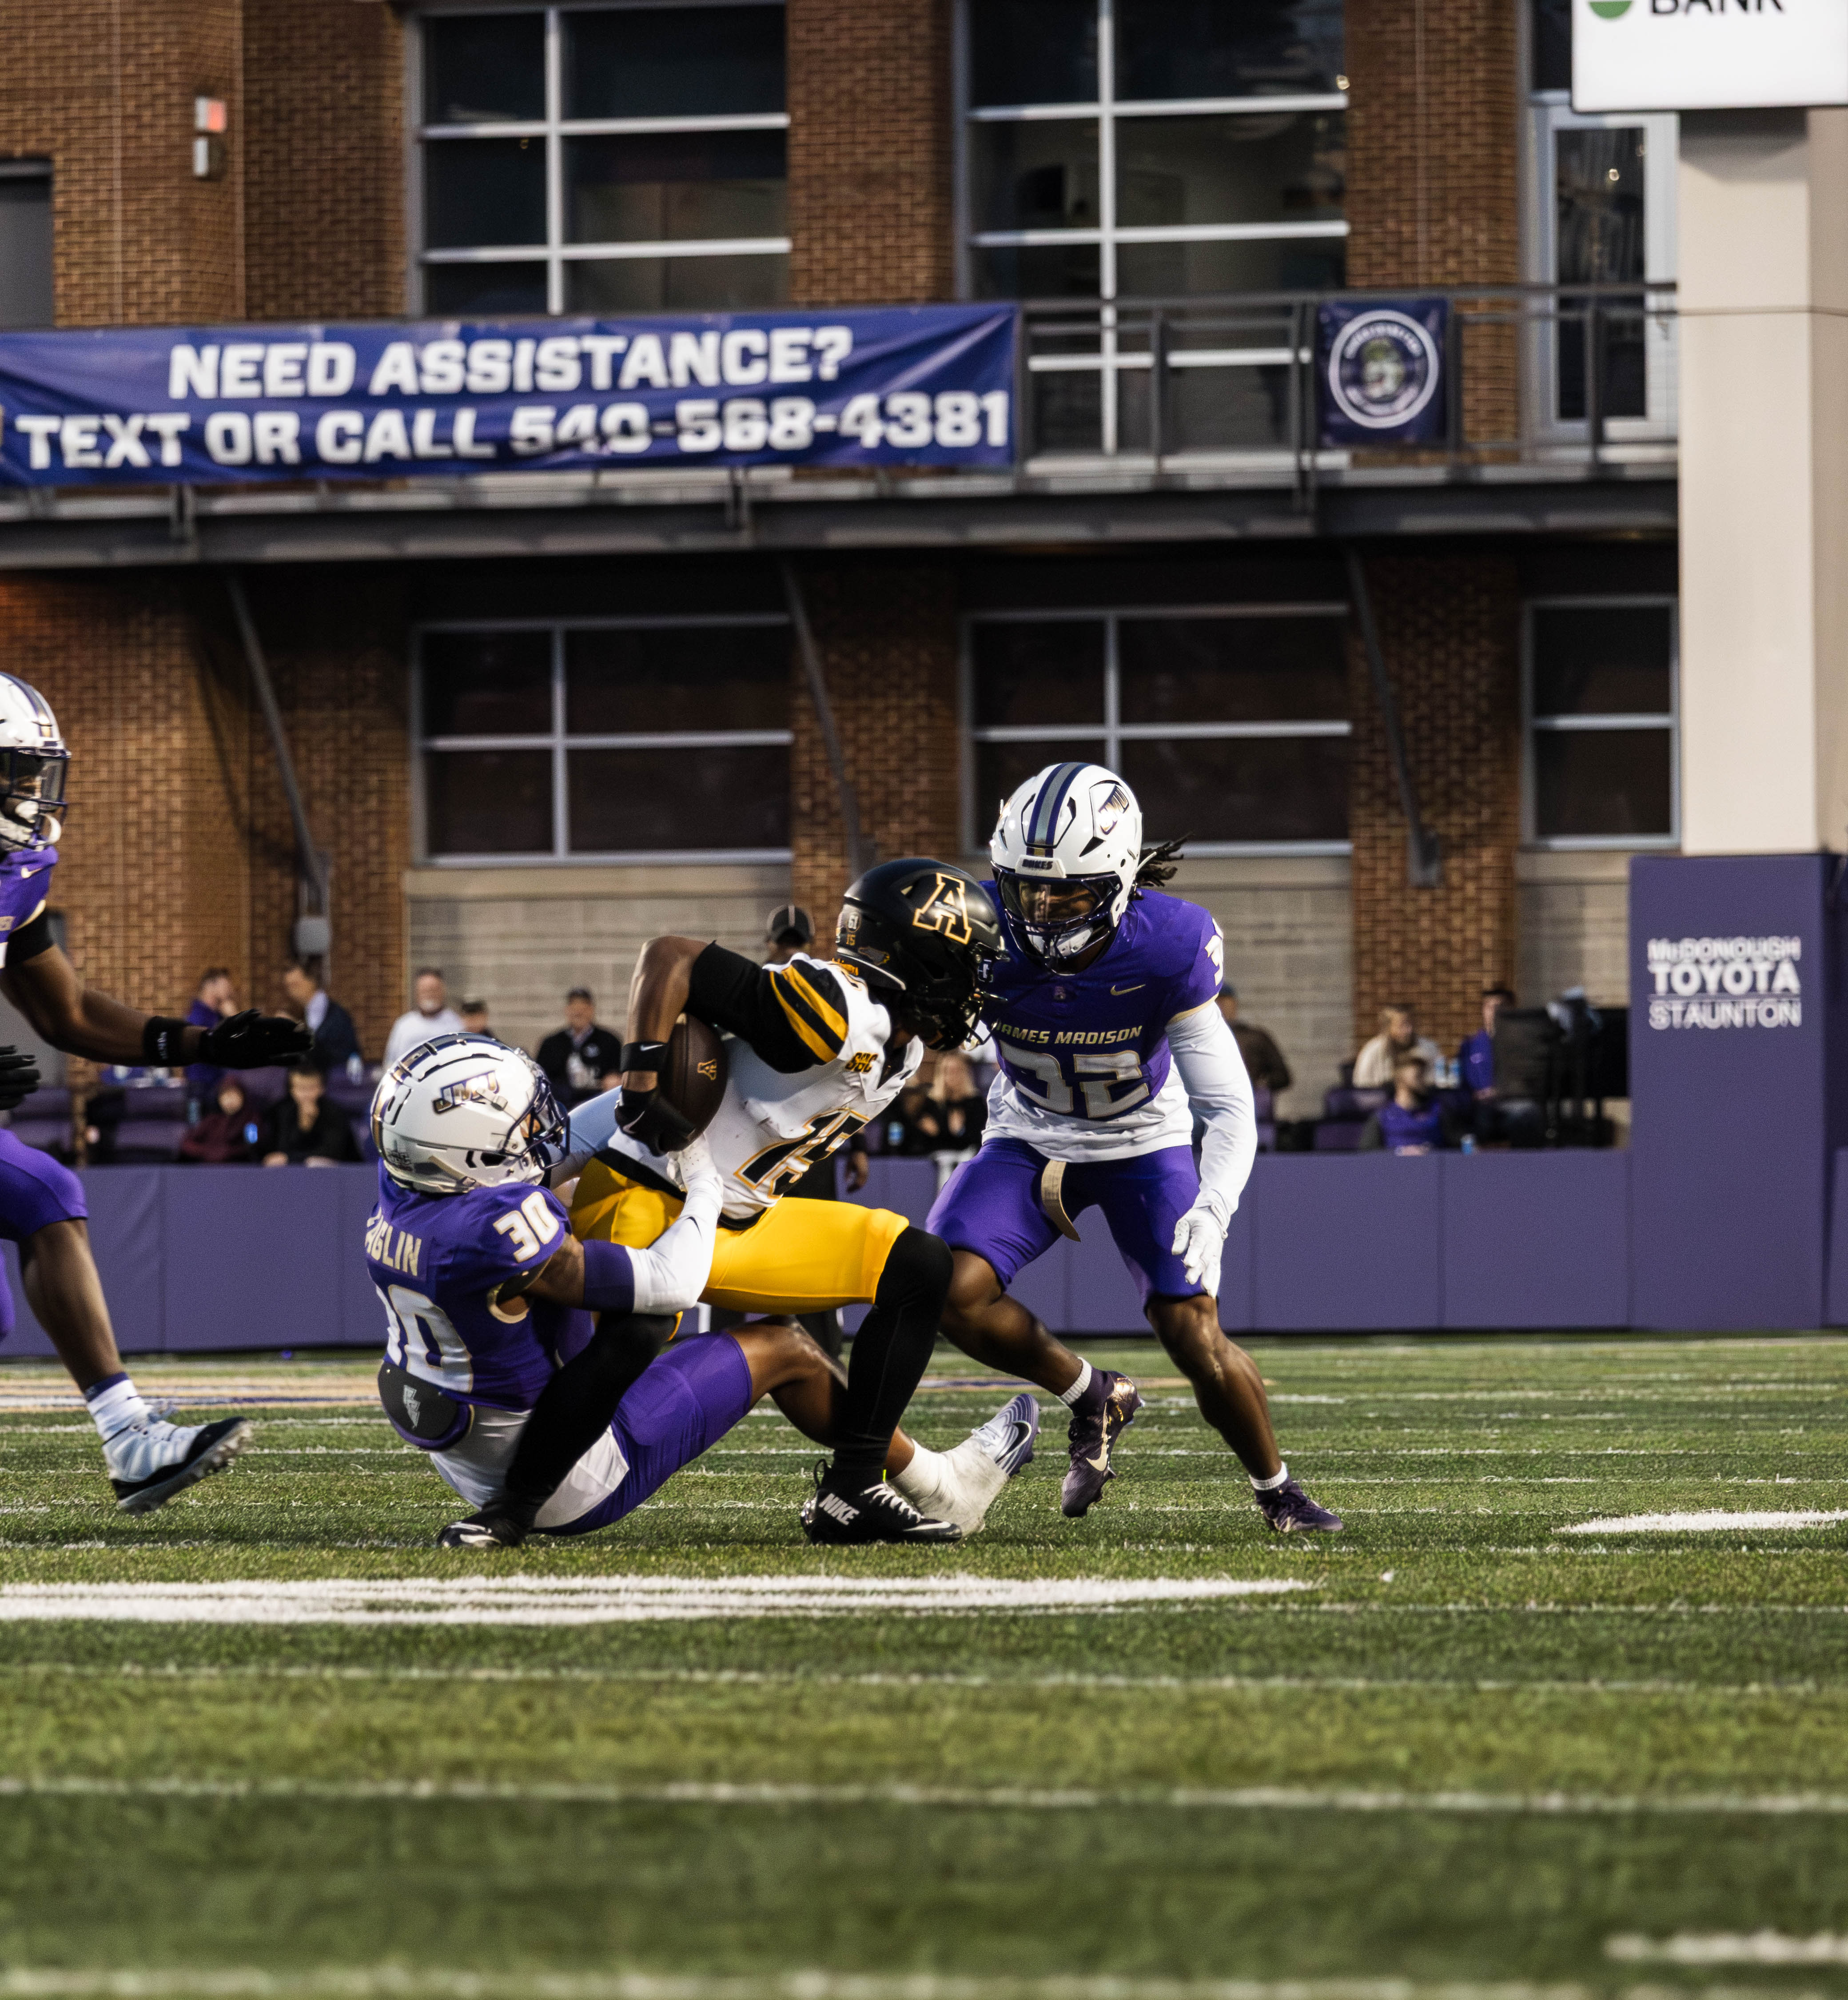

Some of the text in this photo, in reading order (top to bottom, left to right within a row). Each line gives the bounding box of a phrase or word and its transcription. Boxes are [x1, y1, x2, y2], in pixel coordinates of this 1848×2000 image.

[169, 327, 853, 399] NEED ASSISTANCE?
[16, 390, 1011, 470] TEXT OR CALL 540-568-4381
[1648, 958, 1801, 996] TOYOTA
[1649, 999, 1802, 1030] STAUNTON
[1054, 1025, 1143, 1044] MADISON
[492, 1191, 560, 1263] 30
[818, 1493, 860, 1525] NIKE
